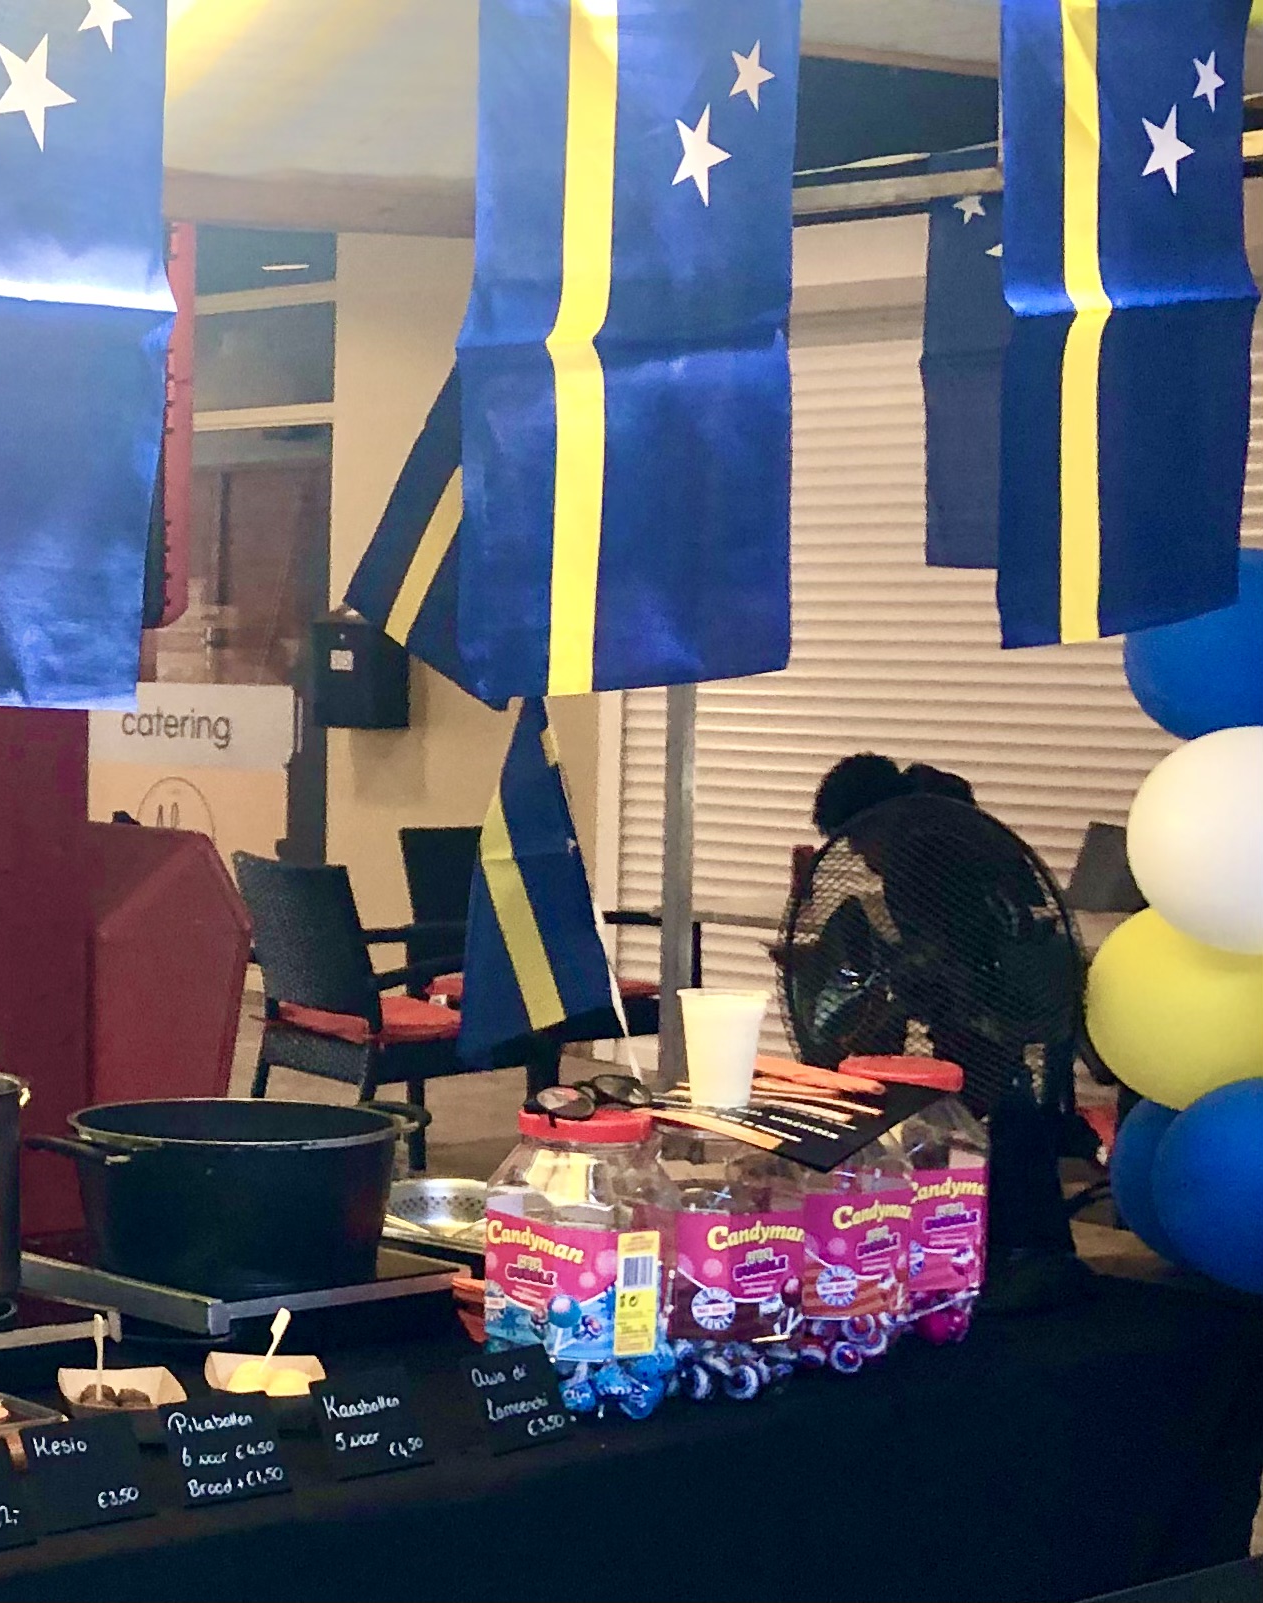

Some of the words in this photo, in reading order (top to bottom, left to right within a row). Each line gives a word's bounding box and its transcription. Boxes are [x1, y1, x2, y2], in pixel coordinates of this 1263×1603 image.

[122, 706, 232, 749] catering
[487, 1219, 584, 1265] Candyman
[32, 1436, 87, 1457] Kesio
[335, 1432, 346, 1451] 5
[187, 1478, 233, 1498] Brood
